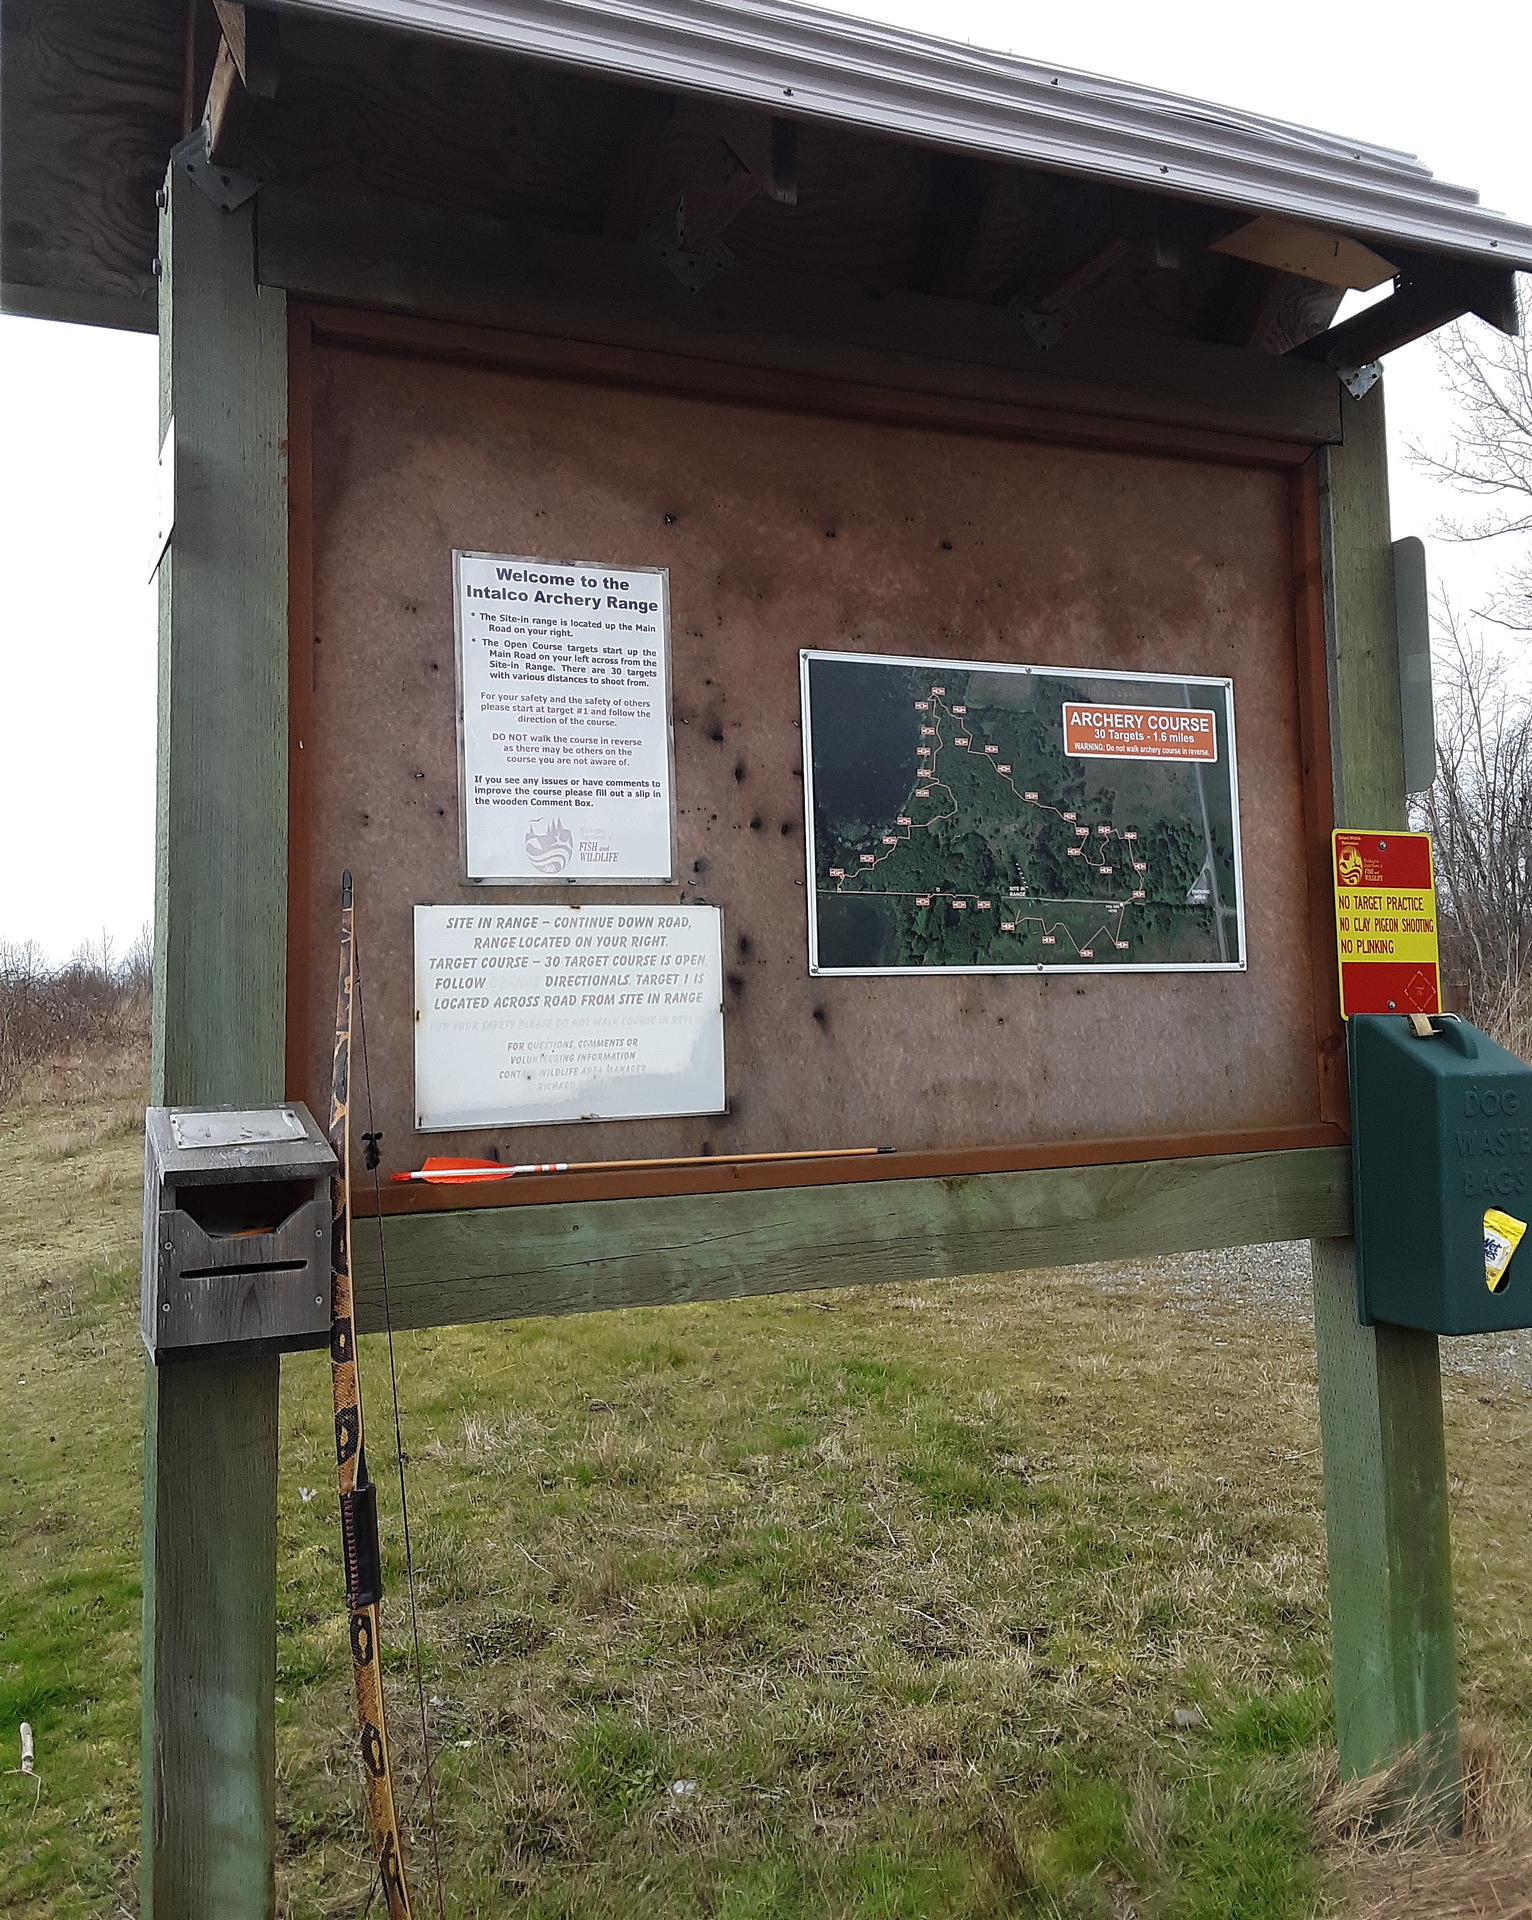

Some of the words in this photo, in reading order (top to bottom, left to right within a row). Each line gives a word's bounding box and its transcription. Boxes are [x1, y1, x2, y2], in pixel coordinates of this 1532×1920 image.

[495, 567, 575, 586] Welcome
[580, 575, 597, 588] to
[602, 576, 629, 590] the
[466, 584, 528, 601] Intalco
[533, 590, 601, 610] Archery
[606, 595, 658, 614] Range
[479, 612, 496, 621] The
[499, 614, 528, 623] Site-in
[532, 617, 557, 626] range
[560, 617, 567, 626] is
[570, 618, 601, 628] located
[604, 623, 615, 631] up
[618, 622, 632, 630] the
[635, 623, 655, 632] Main
[488, 623, 511, 632] Road
[527, 628, 547, 636] your
[549, 627, 573, 637] right.
[481, 638, 498, 646] The
[503, 639, 527, 649] Open
[532, 641, 562, 650] Course
[566, 643, 598, 653] targets
[602, 646, 622, 654] start
[627, 649, 638, 657] up
[642, 648, 656, 656] the
[489, 649, 511, 658] Main
[513, 650, 536, 659] Road
[552, 654, 572, 662] your
[574, 654, 589, 663] left
[591, 656, 618, 664] across
[620, 657, 640, 666] from
[642, 658, 656, 667] the
[489, 660, 519, 669] Site-in
[525, 662, 555, 672] Range.
[560, 664, 586, 673] There
[610, 666, 621, 675] 30
[626, 668, 657, 678] targets
[489, 670, 510, 679] with
[512, 672, 544, 681] various
[546, 673, 587, 683] distances
[589, 676, 598, 684] to
[600, 676, 624, 685] shoot
[626, 678, 649, 686] from.
[1070, 711, 1143, 728] ARCHERY
[1147, 715, 1209, 732] COURSE
[492, 732, 505, 740] DO
[508, 733, 527, 741] NOT
[529, 734, 550, 742] walk
[553, 735, 567, 743] the
[600, 736, 608, 744] in
[1094, 728, 1105, 738] 30
[1107, 728, 1144, 742] Targets
[1152, 731, 1167, 741] 1.6
[1168, 732, 1194, 742] miles
[1074, 742, 1105, 751] WARNING:
[1105, 743, 1114, 751] Do
[1125, 744, 1139, 752] walk
[1139, 745, 1161, 755] archery
[1181, 746, 1187, 754] in
[538, 756, 554, 764] you
[618, 758, 629, 766] of.
[474, 774, 482, 783] If
[484, 776, 501, 784] you
[522, 778, 538, 786] any
[541, 776, 568, 785] issues
[582, 777, 603, 786] have
[605, 779, 649, 787] comments
[474, 785, 511, 795] improve
[514, 786, 529, 794] the
[564, 788, 592, 797] please
[595, 788, 606, 796] fill
[609, 789, 624, 797] out
[635, 789, 650, 798] slip
[474, 796, 490, 804] the
[492, 797, 528, 805] wooden
[530, 797, 572, 806] Comment
[574, 798, 593, 807] Box.
[578, 841, 597, 851] FISH
[579, 852, 618, 862] WILDLIFE
[1338, 894, 1350, 909] NO
[1353, 895, 1382, 910] TARGET
[1386, 896, 1424, 910] PRACTICE
[446, 916, 473, 928] SITE
[477, 916, 492, 928] IN
[496, 916, 538, 929] RANGE
[554, 916, 614, 928] CONTINUE
[617, 916, 654, 928] DOWN
[1339, 916, 1349, 931] NO
[1353, 917, 1370, 931] CLAY
[1374, 917, 1398, 932] PIGEON
[1401, 918, 1433, 932] SHOOTING
[473, 936, 516, 949] RANGE
[518, 936, 571, 948] LOCATED
[575, 936, 592, 947] ON
[596, 935, 627, 948] YOUR
[1340, 938, 1352, 953] NO
[1356, 939, 1394, 954] PLINKING
[428, 957, 478, 970] TARGET
[480, 956, 528, 968] COURSE
[544, 955, 560, 967] 30
[564, 955, 609, 967] TARGET
[612, 954, 657, 967] COURSE
[660, 954, 671, 965] IS
[434, 977, 486, 989] FOLLOW
[636, 973, 679, 985] TARGET
[693, 973, 704, 984] IS
[434, 996, 489, 1009] LOCATED
[493, 995, 540, 1008] ACROSS
[543, 994, 576, 1008] ROAD
[580, 993, 614, 1006] FROM
[618, 992, 643, 1004] SITE
[646, 992, 660, 1004] IN
[507, 1042, 525, 1051] FOR
[626, 1038, 638, 1047] OR
[1464, 1089, 1520, 1117] DOG
[1455, 1128, 1529, 1157] WASTE
[1463, 1168, 1526, 1197] BAGS
